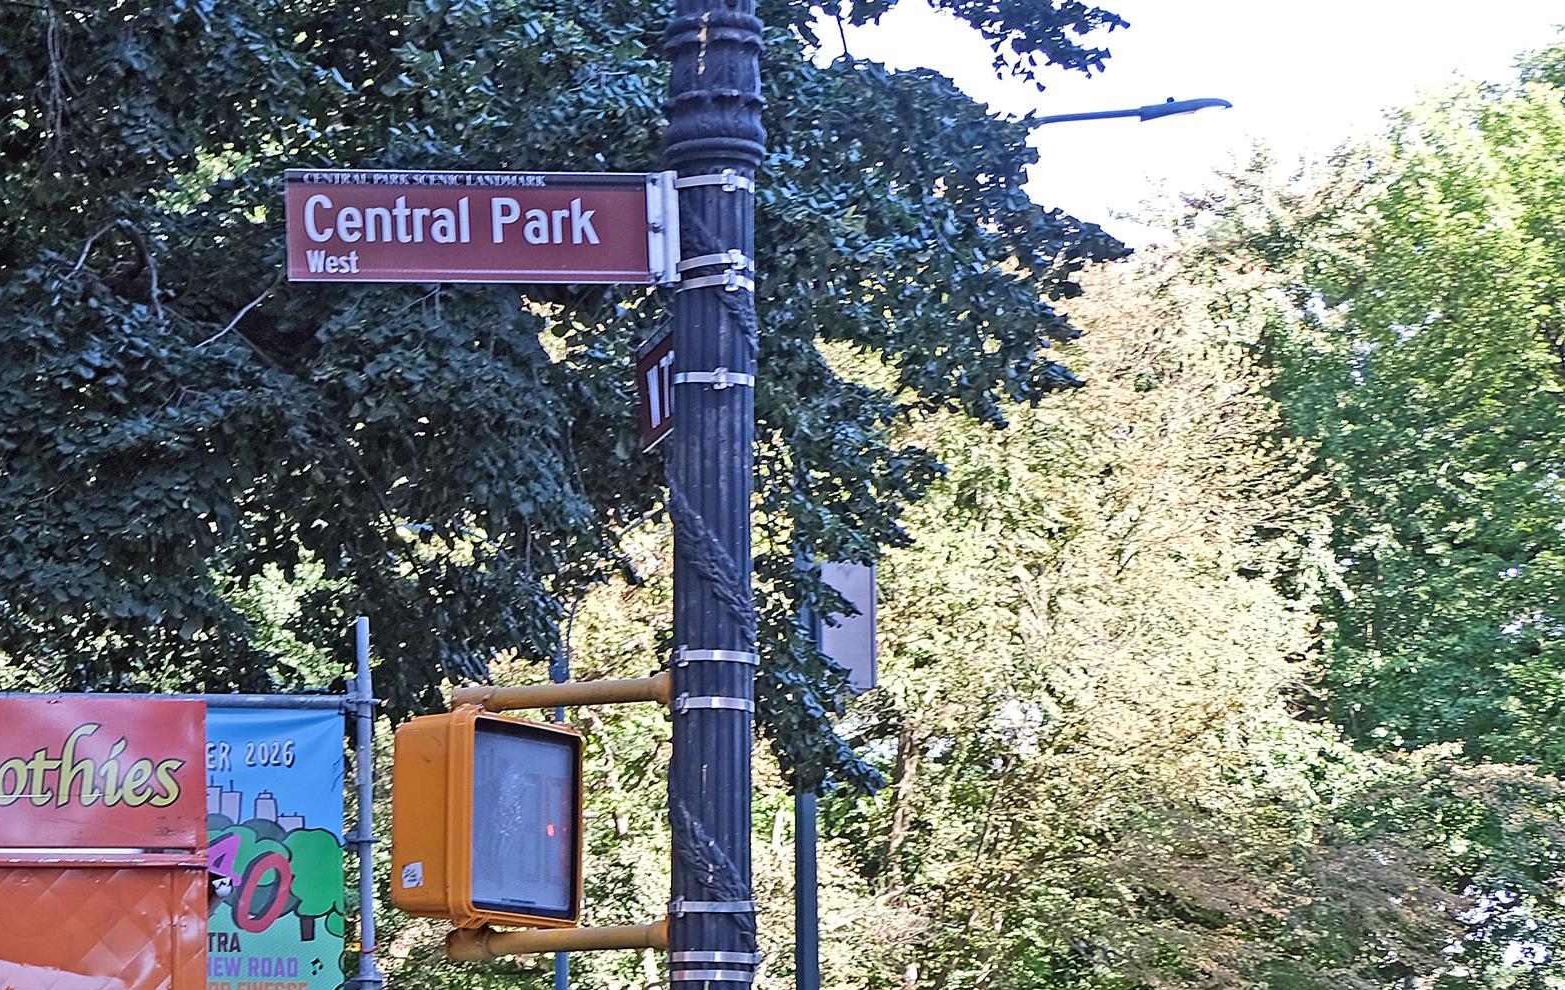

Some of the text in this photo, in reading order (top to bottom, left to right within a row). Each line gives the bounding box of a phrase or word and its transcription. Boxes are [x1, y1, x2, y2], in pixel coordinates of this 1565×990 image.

[302, 172, 546, 187] CENTRAL PARK SCENIC LANDMARK
[303, 194, 601, 246] Central Park
[305, 249, 360, 274] West
[206, 739, 295, 773] ER 2026
[207, 932, 241, 953] TRA
[247, 957, 298, 978] ROAD
